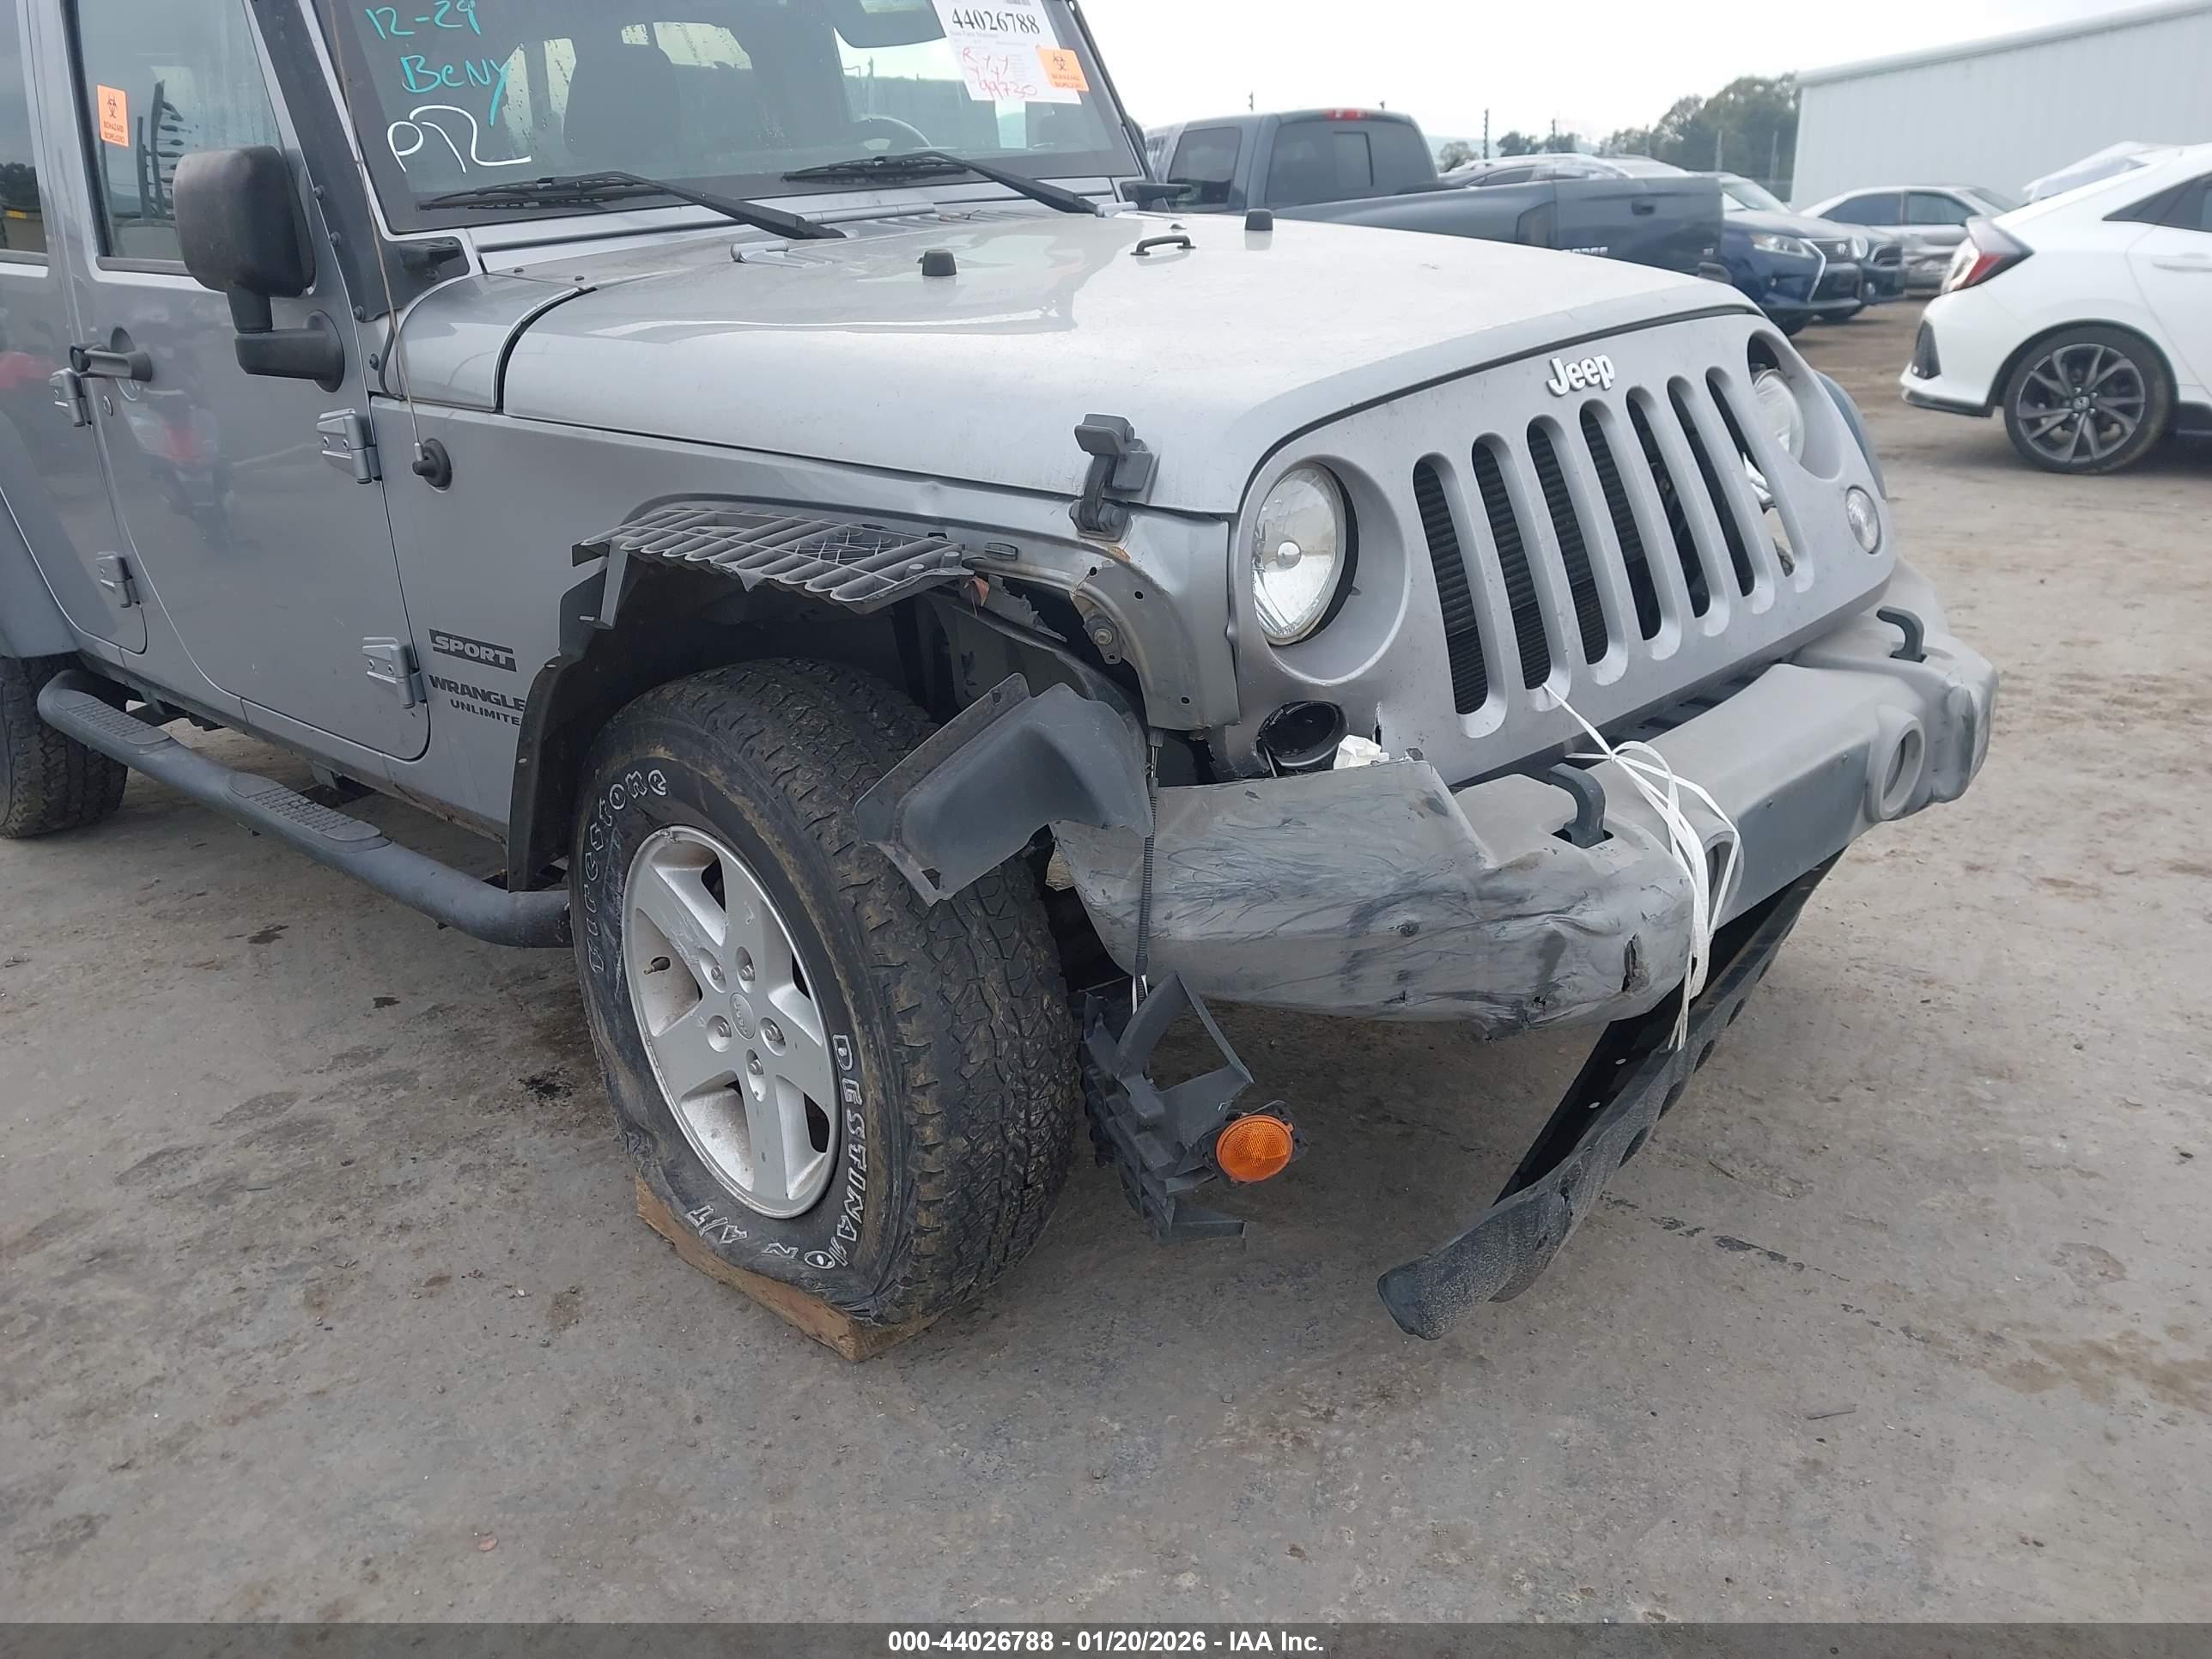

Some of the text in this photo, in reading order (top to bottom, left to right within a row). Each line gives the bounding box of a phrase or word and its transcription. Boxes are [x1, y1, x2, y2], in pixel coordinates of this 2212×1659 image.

[952, 8, 1040, 34] 44026788
[1547, 354, 1615, 398] Jeep
[432, 635, 514, 665] SPORT
[428, 674, 526, 712] WRANGLE
[450, 698, 520, 726] UNLIMITE
